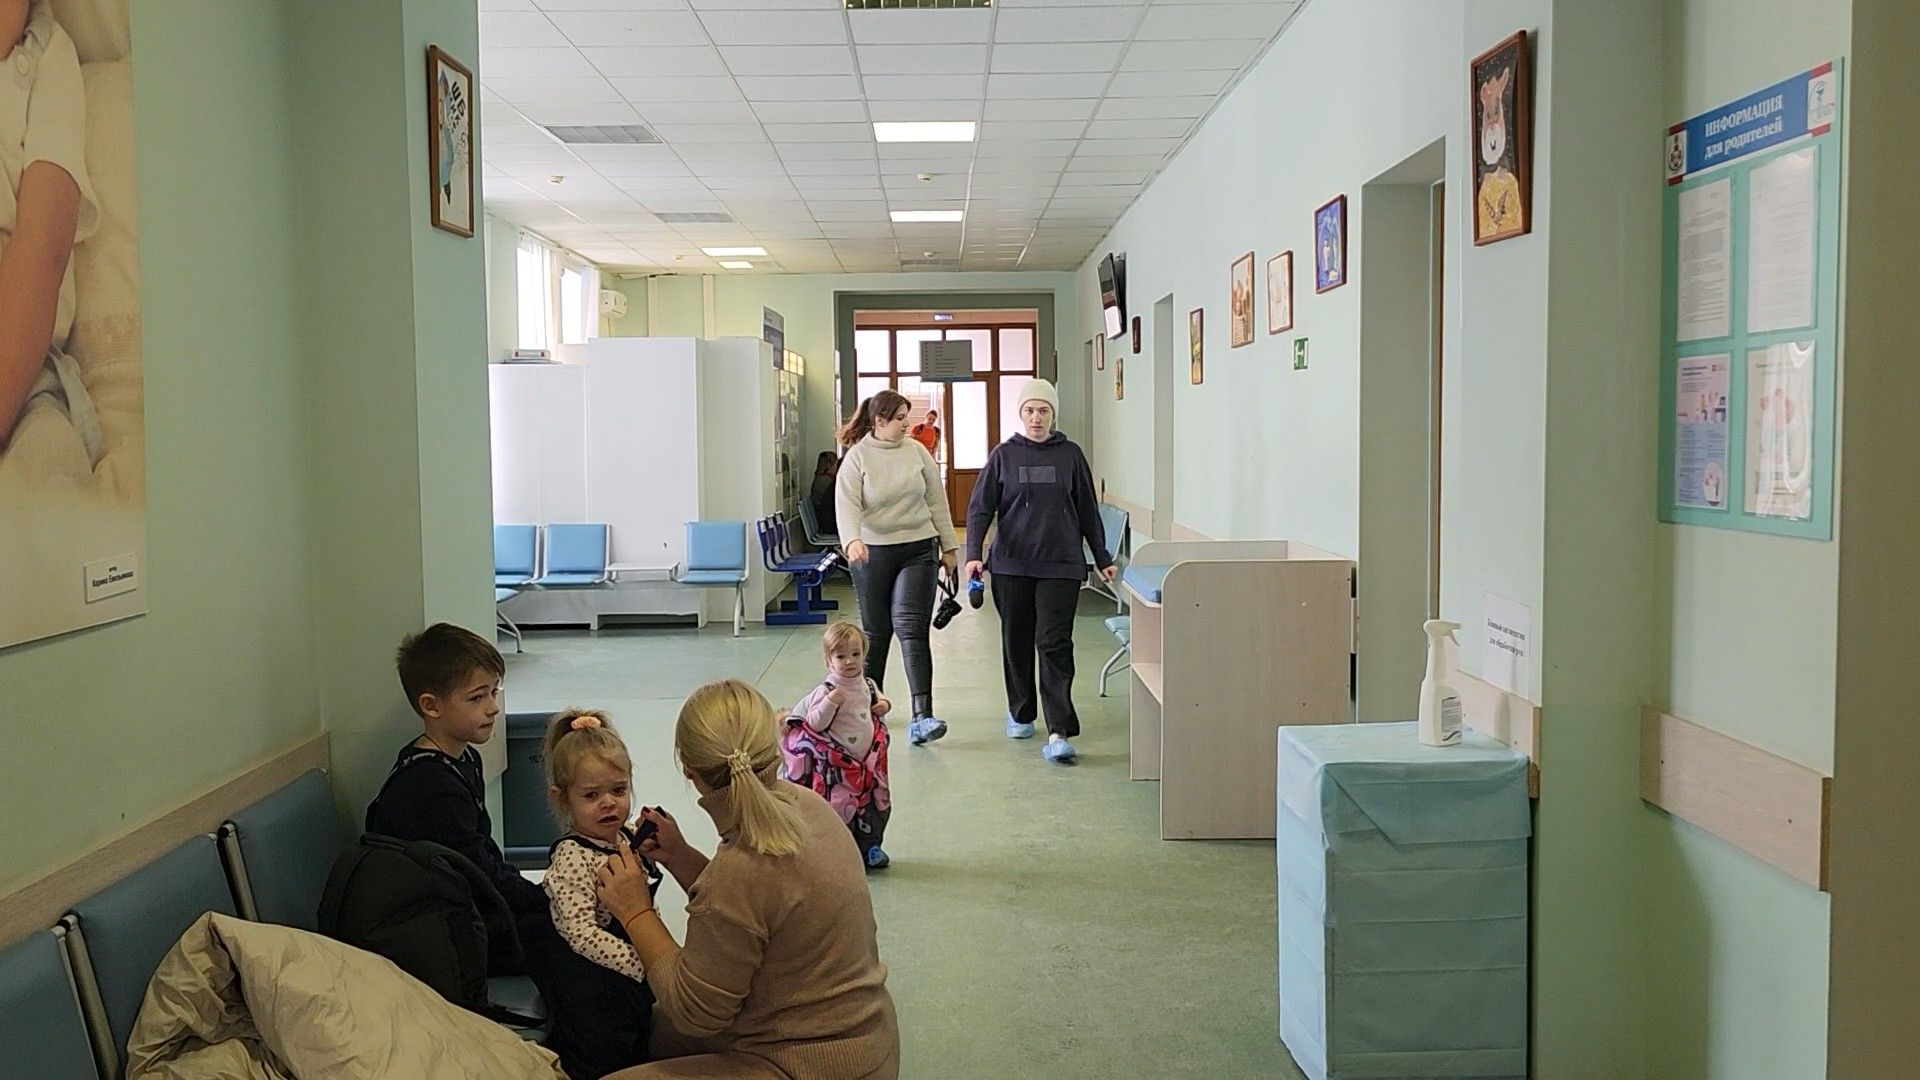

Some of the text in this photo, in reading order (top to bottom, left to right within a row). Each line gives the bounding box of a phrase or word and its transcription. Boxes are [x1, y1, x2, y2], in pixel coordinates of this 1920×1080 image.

[1704, 94, 1783, 137] ИНФОРМАЦИЯ
[1704, 116, 1783, 160] для родителей
